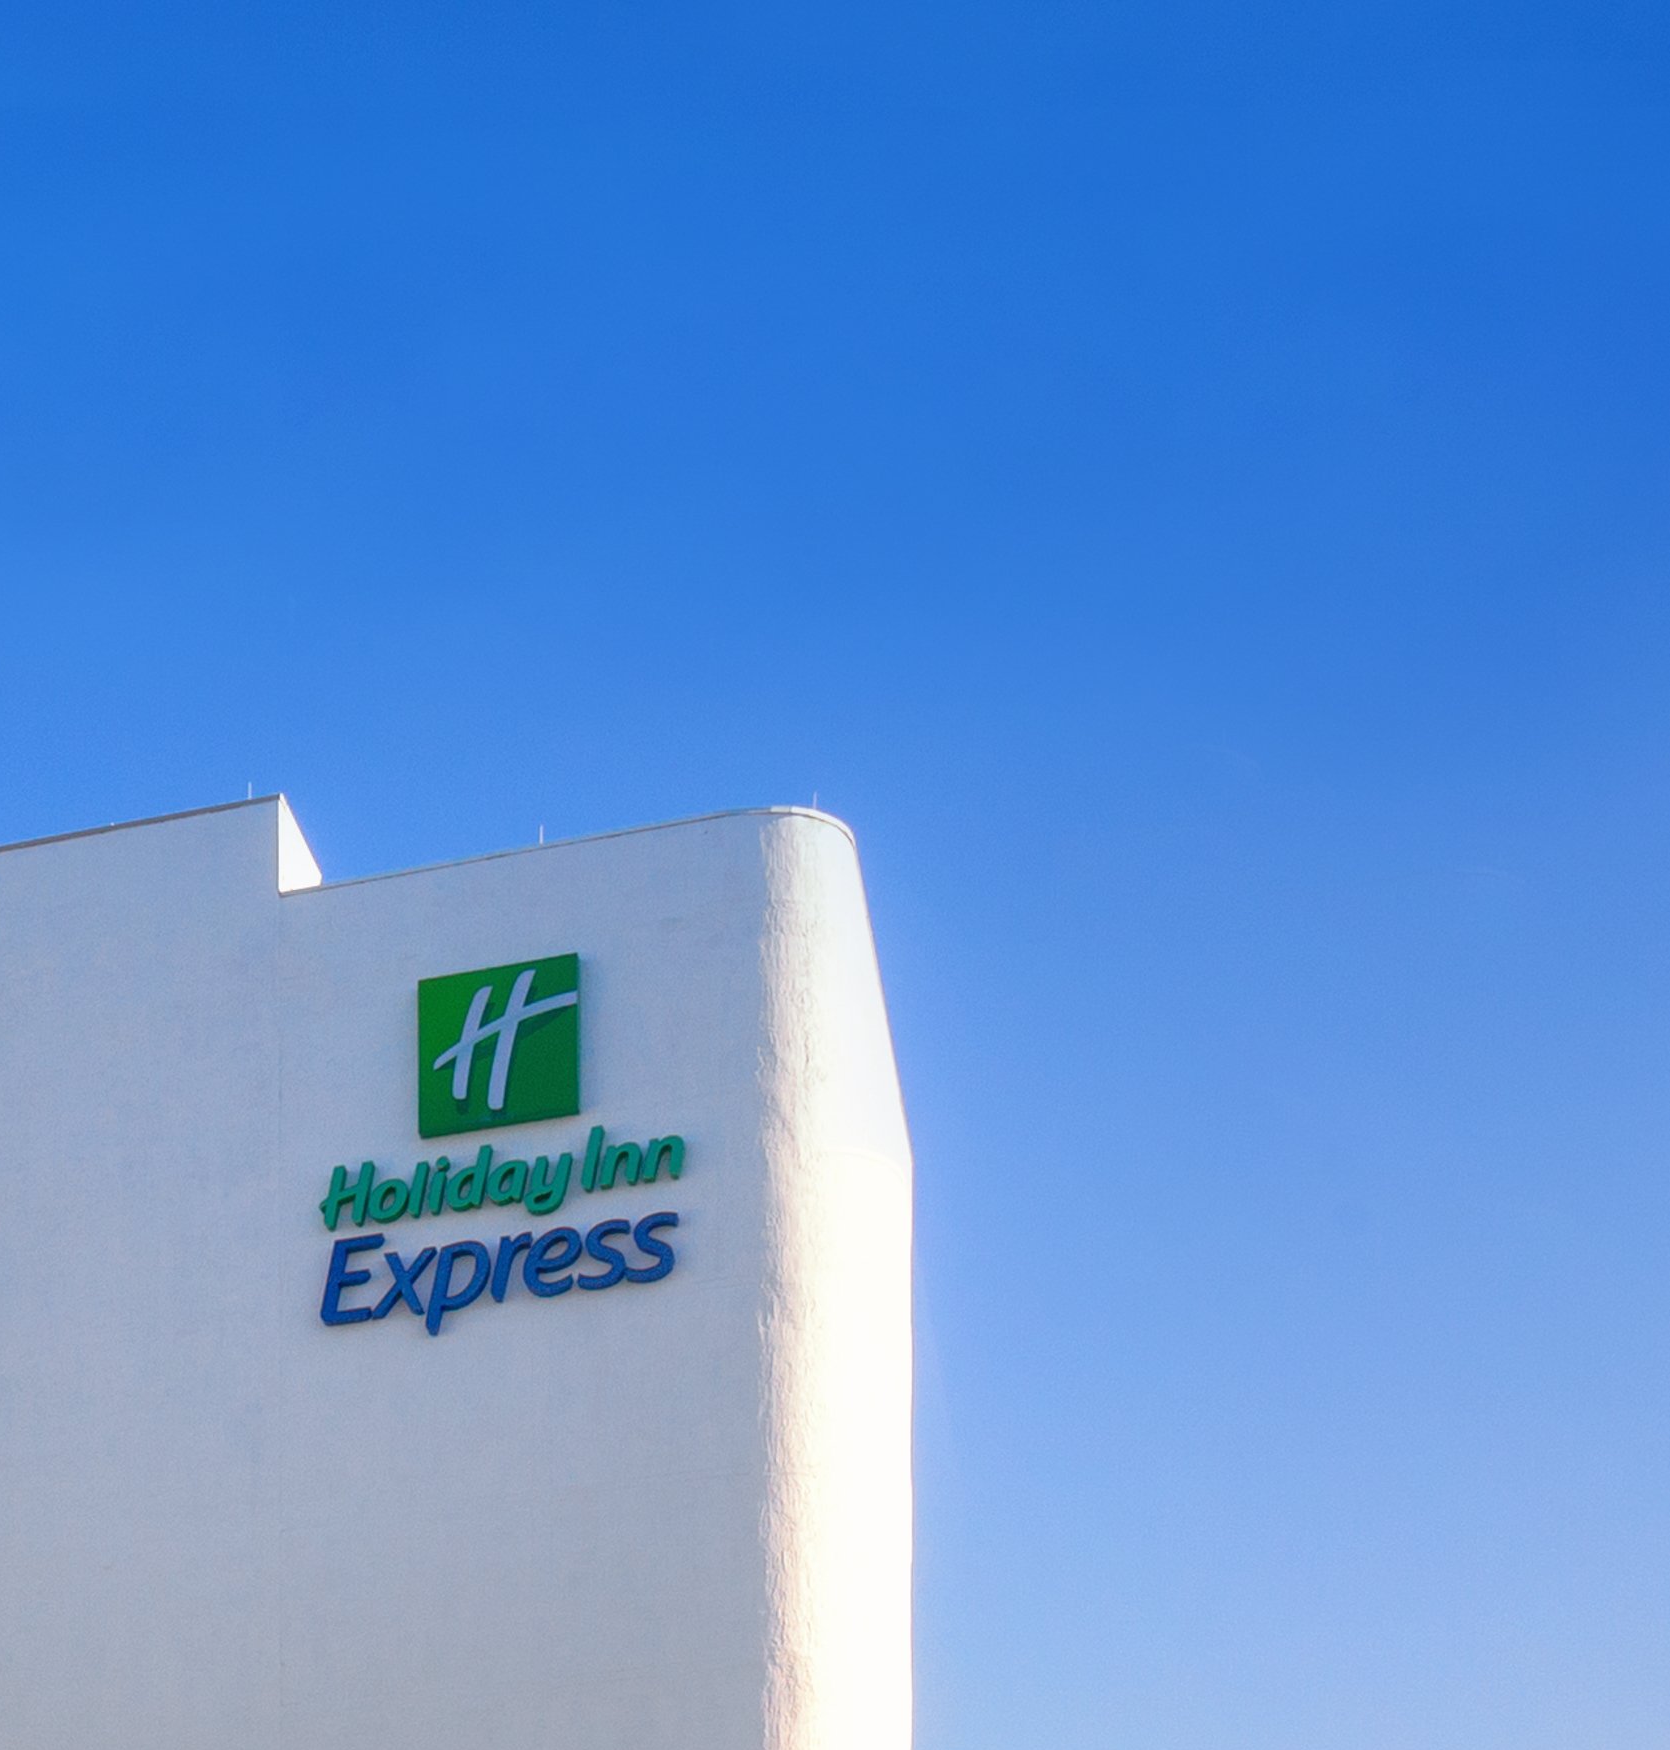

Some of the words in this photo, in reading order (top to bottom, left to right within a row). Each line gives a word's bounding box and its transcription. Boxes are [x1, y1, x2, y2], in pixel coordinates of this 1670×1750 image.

[319, 1144, 573, 1231] Holiday
[581, 1125, 686, 1192] Inn
[319, 1211, 679, 1336] Express
